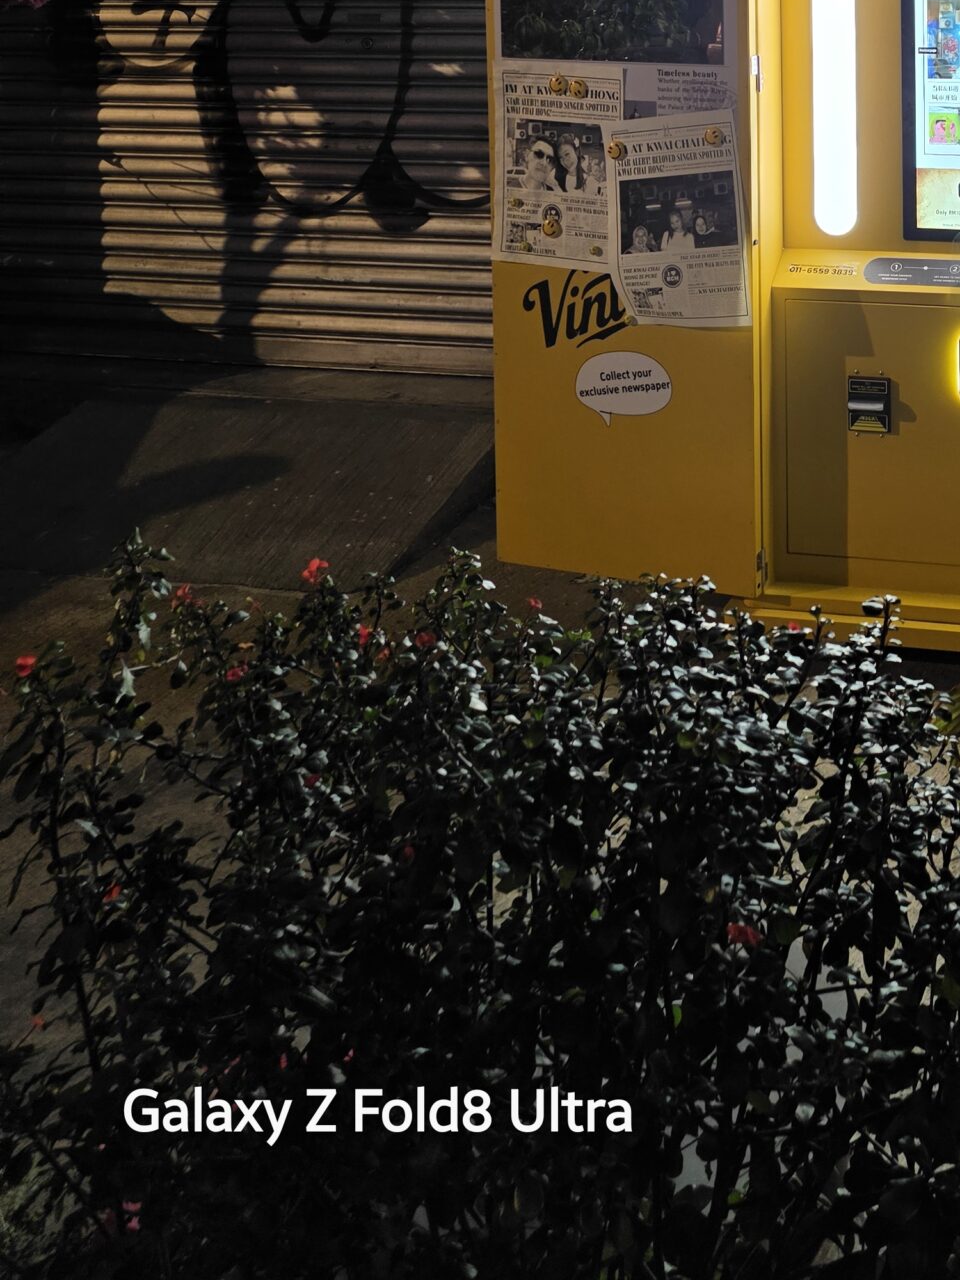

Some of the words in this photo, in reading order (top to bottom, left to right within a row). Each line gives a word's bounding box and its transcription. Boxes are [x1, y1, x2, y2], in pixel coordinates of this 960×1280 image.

[657, 69, 690, 77] Timeless
[692, 70, 718, 81] beauty
[505, 84, 518, 94] IM
[521, 85, 532, 95] AT
[506, 98, 520, 106] STAR
[521, 98, 539, 107] ALERT!
[540, 99, 563, 109] BELOVED
[564, 101, 584, 111] SINGER
[585, 102, 610, 112] SPOTTED
[611, 105, 618, 113] IN
[522, 107, 535, 115] CHAI
[632, 143, 643, 153] AT
[617, 158, 631, 167] STAR
[633, 157, 650, 166] ALERT!
[652, 155, 676, 165] BELOVED
[677, 152, 698, 163] SINGER
[700, 150, 724, 160] SPOTTED
[725, 149, 732, 157] IN
[618, 168, 632, 177] KWAI
[634, 166, 647, 175] CHAI
[789, 266, 830, 275] 011-6559
[600, 370, 630, 382] Collect
[633, 369, 652, 380] your
[579, 384, 620, 398] exclusive
[622, 381, 671, 393] newspaper
